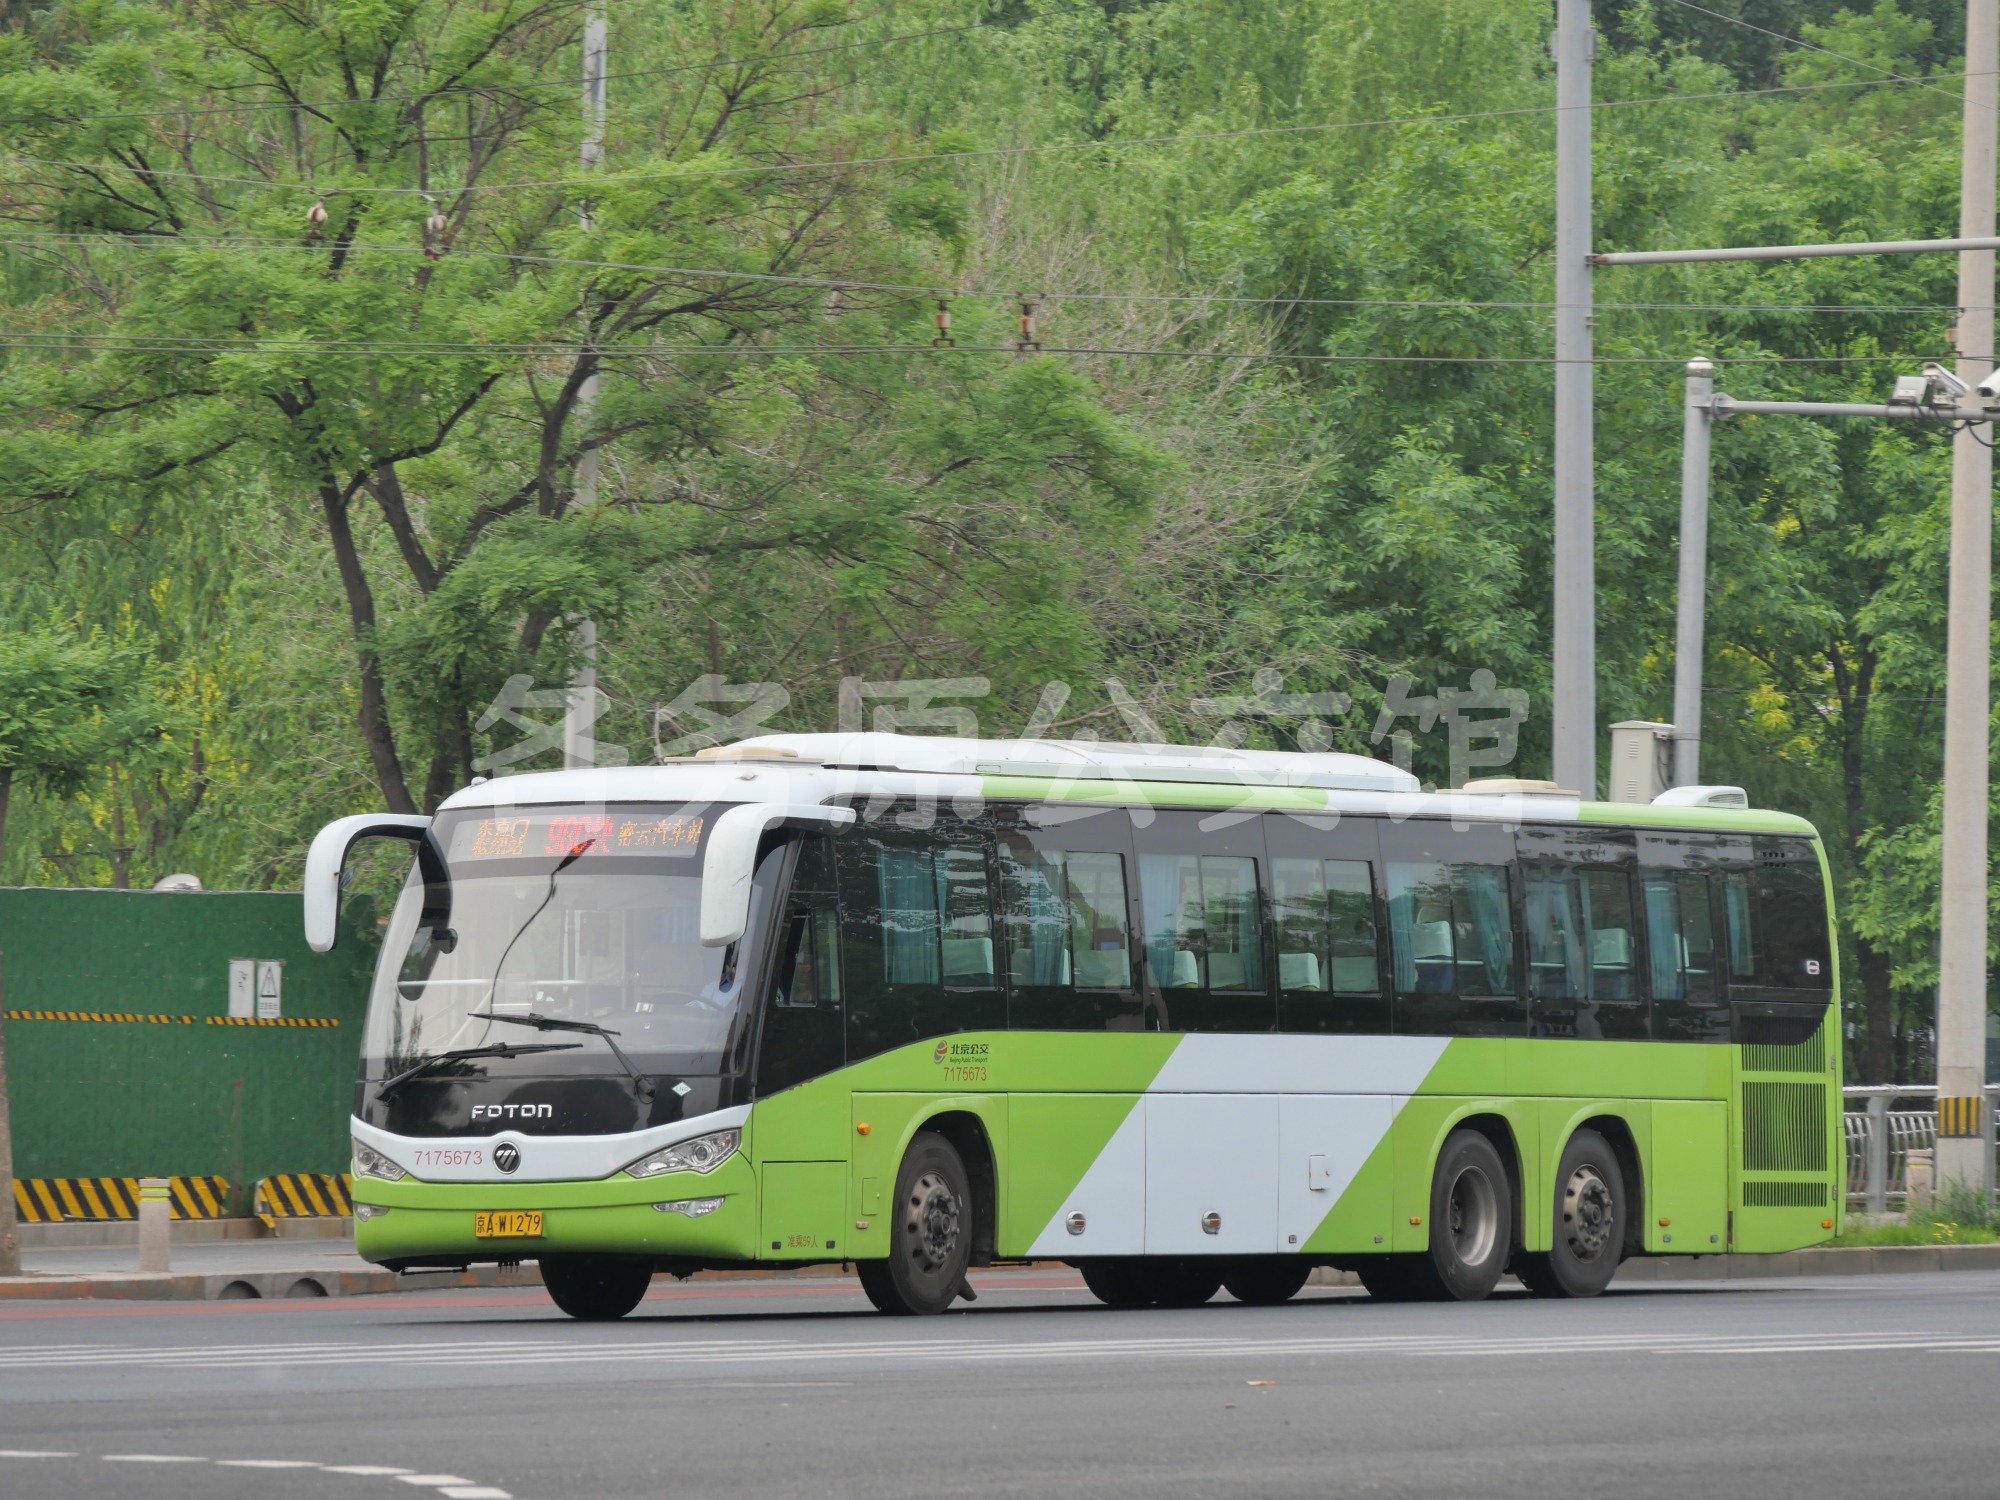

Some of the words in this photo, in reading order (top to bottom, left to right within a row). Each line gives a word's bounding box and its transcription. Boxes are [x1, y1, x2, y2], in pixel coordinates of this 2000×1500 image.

[477, 818, 530, 838] 东直门
[950, 1044, 989, 1055] 北京公交
[943, 1066, 987, 1081] 7175673
[471, 1104, 552, 1119] FOTON
[415, 1150, 483, 1166] 7175673
[787, 1234, 818, 1249] 准乘59人
